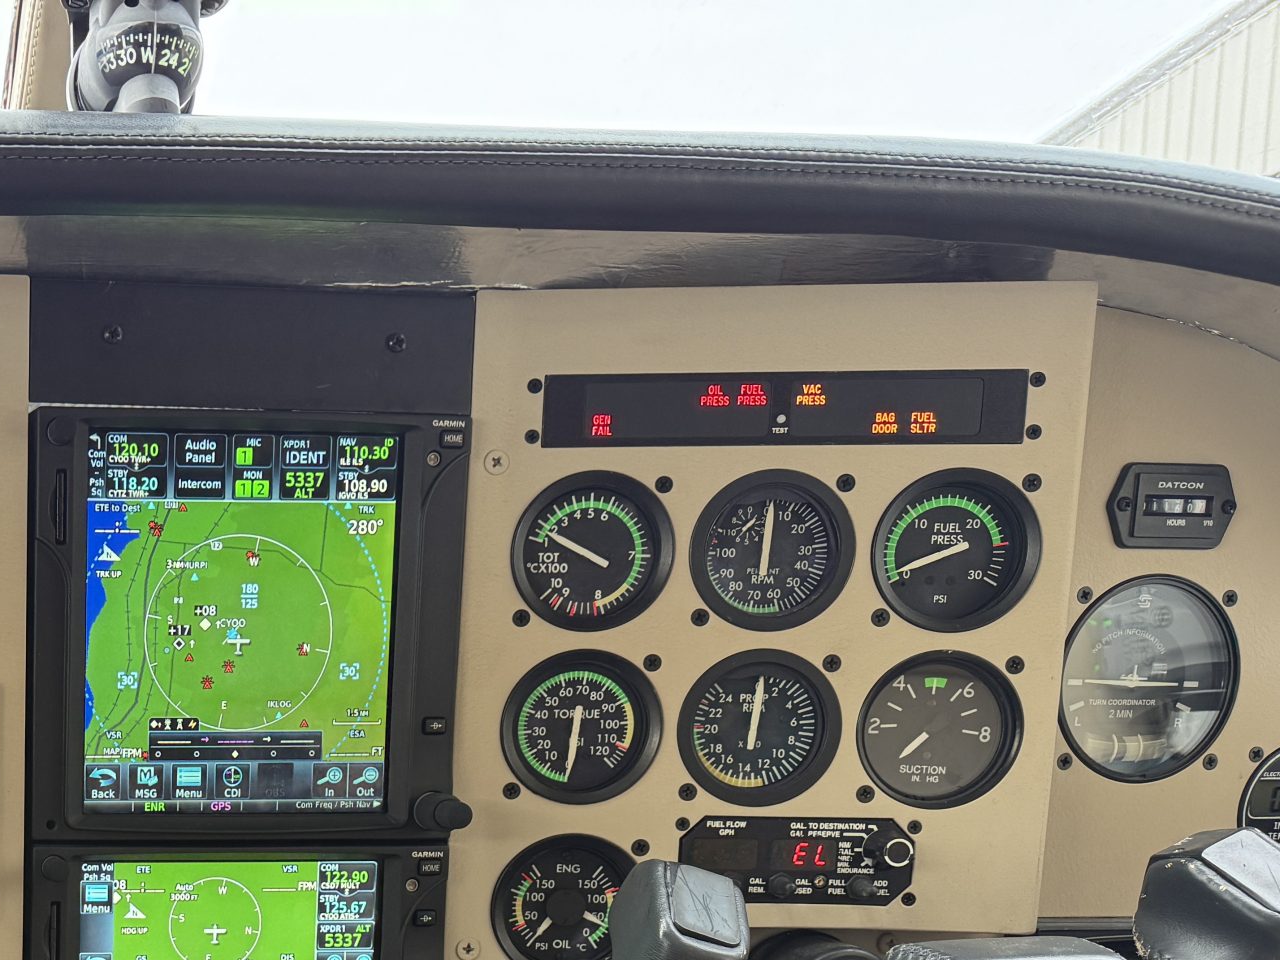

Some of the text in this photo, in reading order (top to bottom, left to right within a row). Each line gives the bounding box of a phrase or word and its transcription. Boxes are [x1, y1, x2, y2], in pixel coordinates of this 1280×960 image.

[117, 48, 137, 65] 30
[158, 49, 178, 68] 24
[708, 386, 722, 394] OIL
[740, 385, 764, 394] FUEL
[802, 384, 822, 394] VAC
[700, 395, 729, 406] PRESS
[737, 394, 768, 405] PRESS
[796, 394, 826, 405] PRESS
[593, 415, 611, 425] GEN
[876, 414, 895, 423] BAG
[911, 412, 936, 422] FUEL
[592, 425, 612, 436] FAIL
[872, 424, 898, 434] DOOR
[910, 422, 936, 434] SLTR
[185, 440, 217, 451] Audio
[186, 452, 215, 463] Panel
[286, 452, 326, 464] IDENT
[178, 479, 221, 489] Intercom
[285, 472, 325, 487] 5337
[1158, 481, 1204, 489] DATCON
[348, 519, 384, 535] 280°
[899, 764, 946, 775] SUCTION
[91, 789, 115, 799] Back
[135, 789, 157, 798] MSG
[176, 788, 202, 798] Menu
[224, 788, 241, 798] CDI
[556, 863, 581, 874] ENG
[552, 939, 571, 950] OIL
